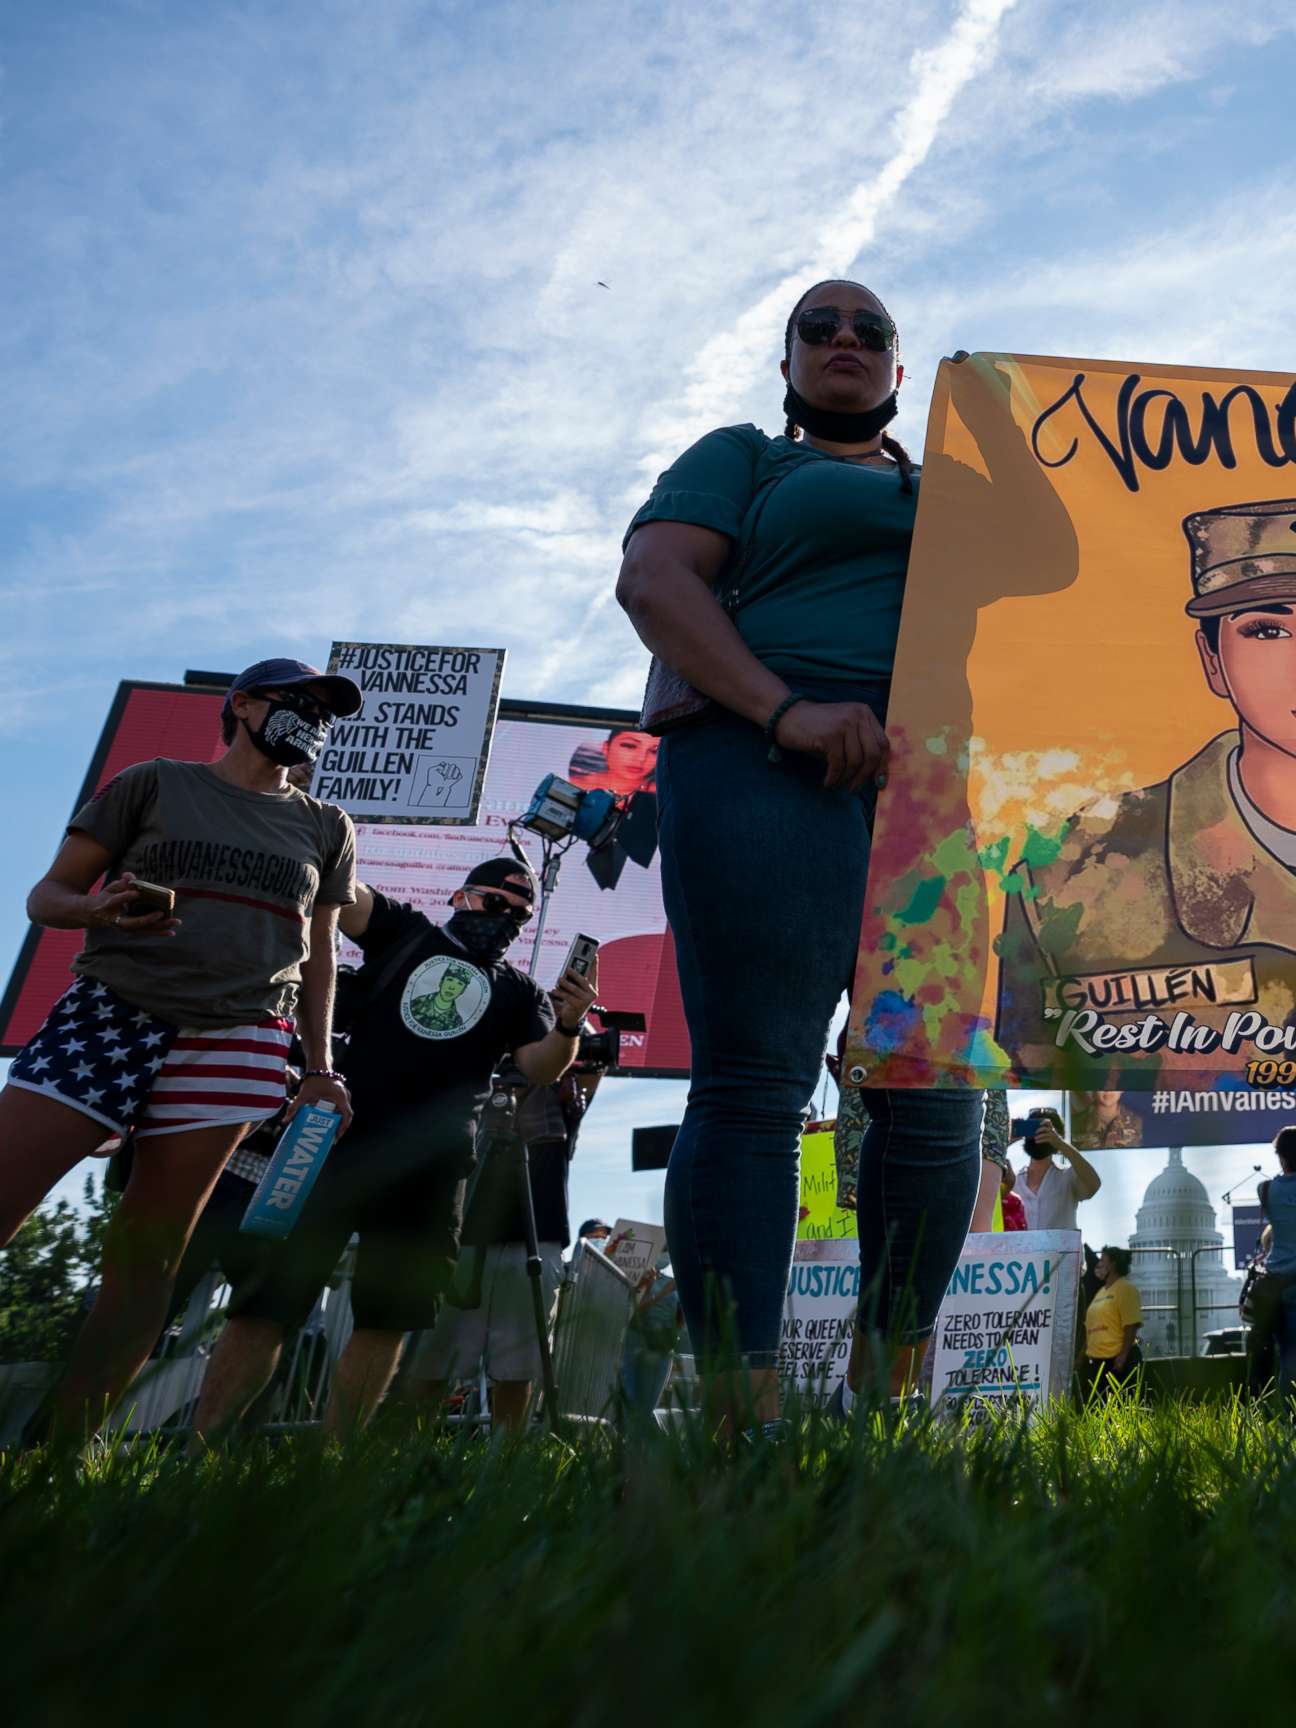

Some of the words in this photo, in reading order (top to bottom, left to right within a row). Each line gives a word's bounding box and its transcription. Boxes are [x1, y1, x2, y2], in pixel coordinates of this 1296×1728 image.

[339, 648, 481, 674] #JUSTICEFOR
[360, 670, 468, 696] VANNESSA
[374, 701, 460, 727] STANDS
[329, 724, 389, 749] WITH
[395, 727, 436, 750] THE
[321, 749, 414, 775] GUILLEN
[315, 776, 401, 801] FAMILY!
[1167, 1008, 1220, 1055] In
[265, 1127, 328, 1210] WATER
[806, 1216, 833, 1241] and
[946, 1260, 1050, 1297] NESSA!
[805, 1318, 855, 1342] QUEENS
[943, 1314, 981, 1332] ZERO
[983, 1309, 1052, 1330] TOLERANCE
[830, 1342, 848, 1360] TO
[942, 1332, 984, 1350] NEEDS
[985, 1331, 1001, 1347] TO
[1002, 1329, 1040, 1348] MEAN
[962, 1348, 1008, 1369] ZERO
